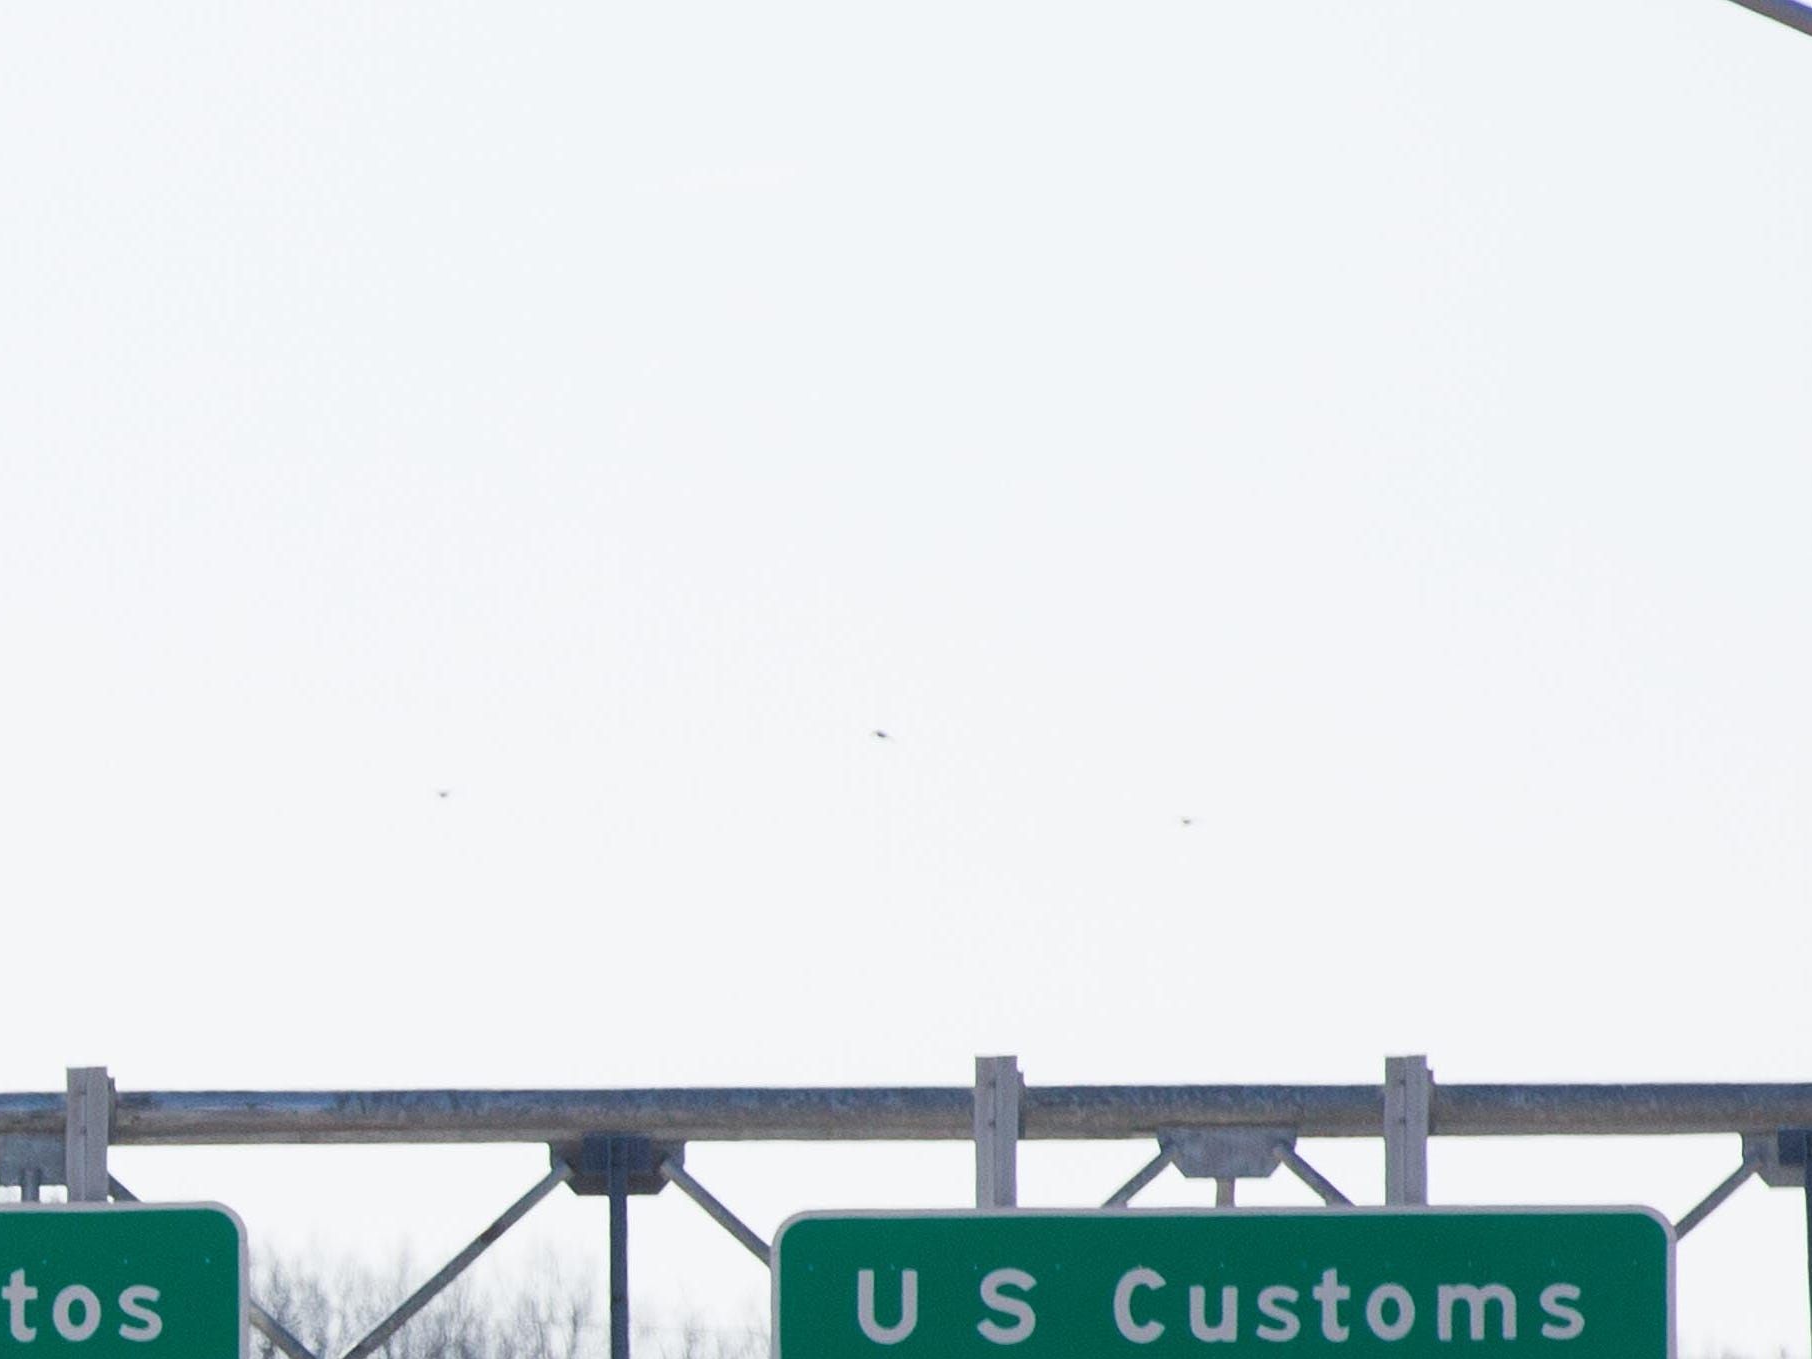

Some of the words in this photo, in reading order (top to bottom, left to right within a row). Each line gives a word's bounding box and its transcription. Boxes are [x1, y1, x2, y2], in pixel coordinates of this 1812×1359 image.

[857, 1269, 918, 1345] U
[977, 1268, 1037, 1344] S
[1113, 1266, 1586, 1344] Customs
